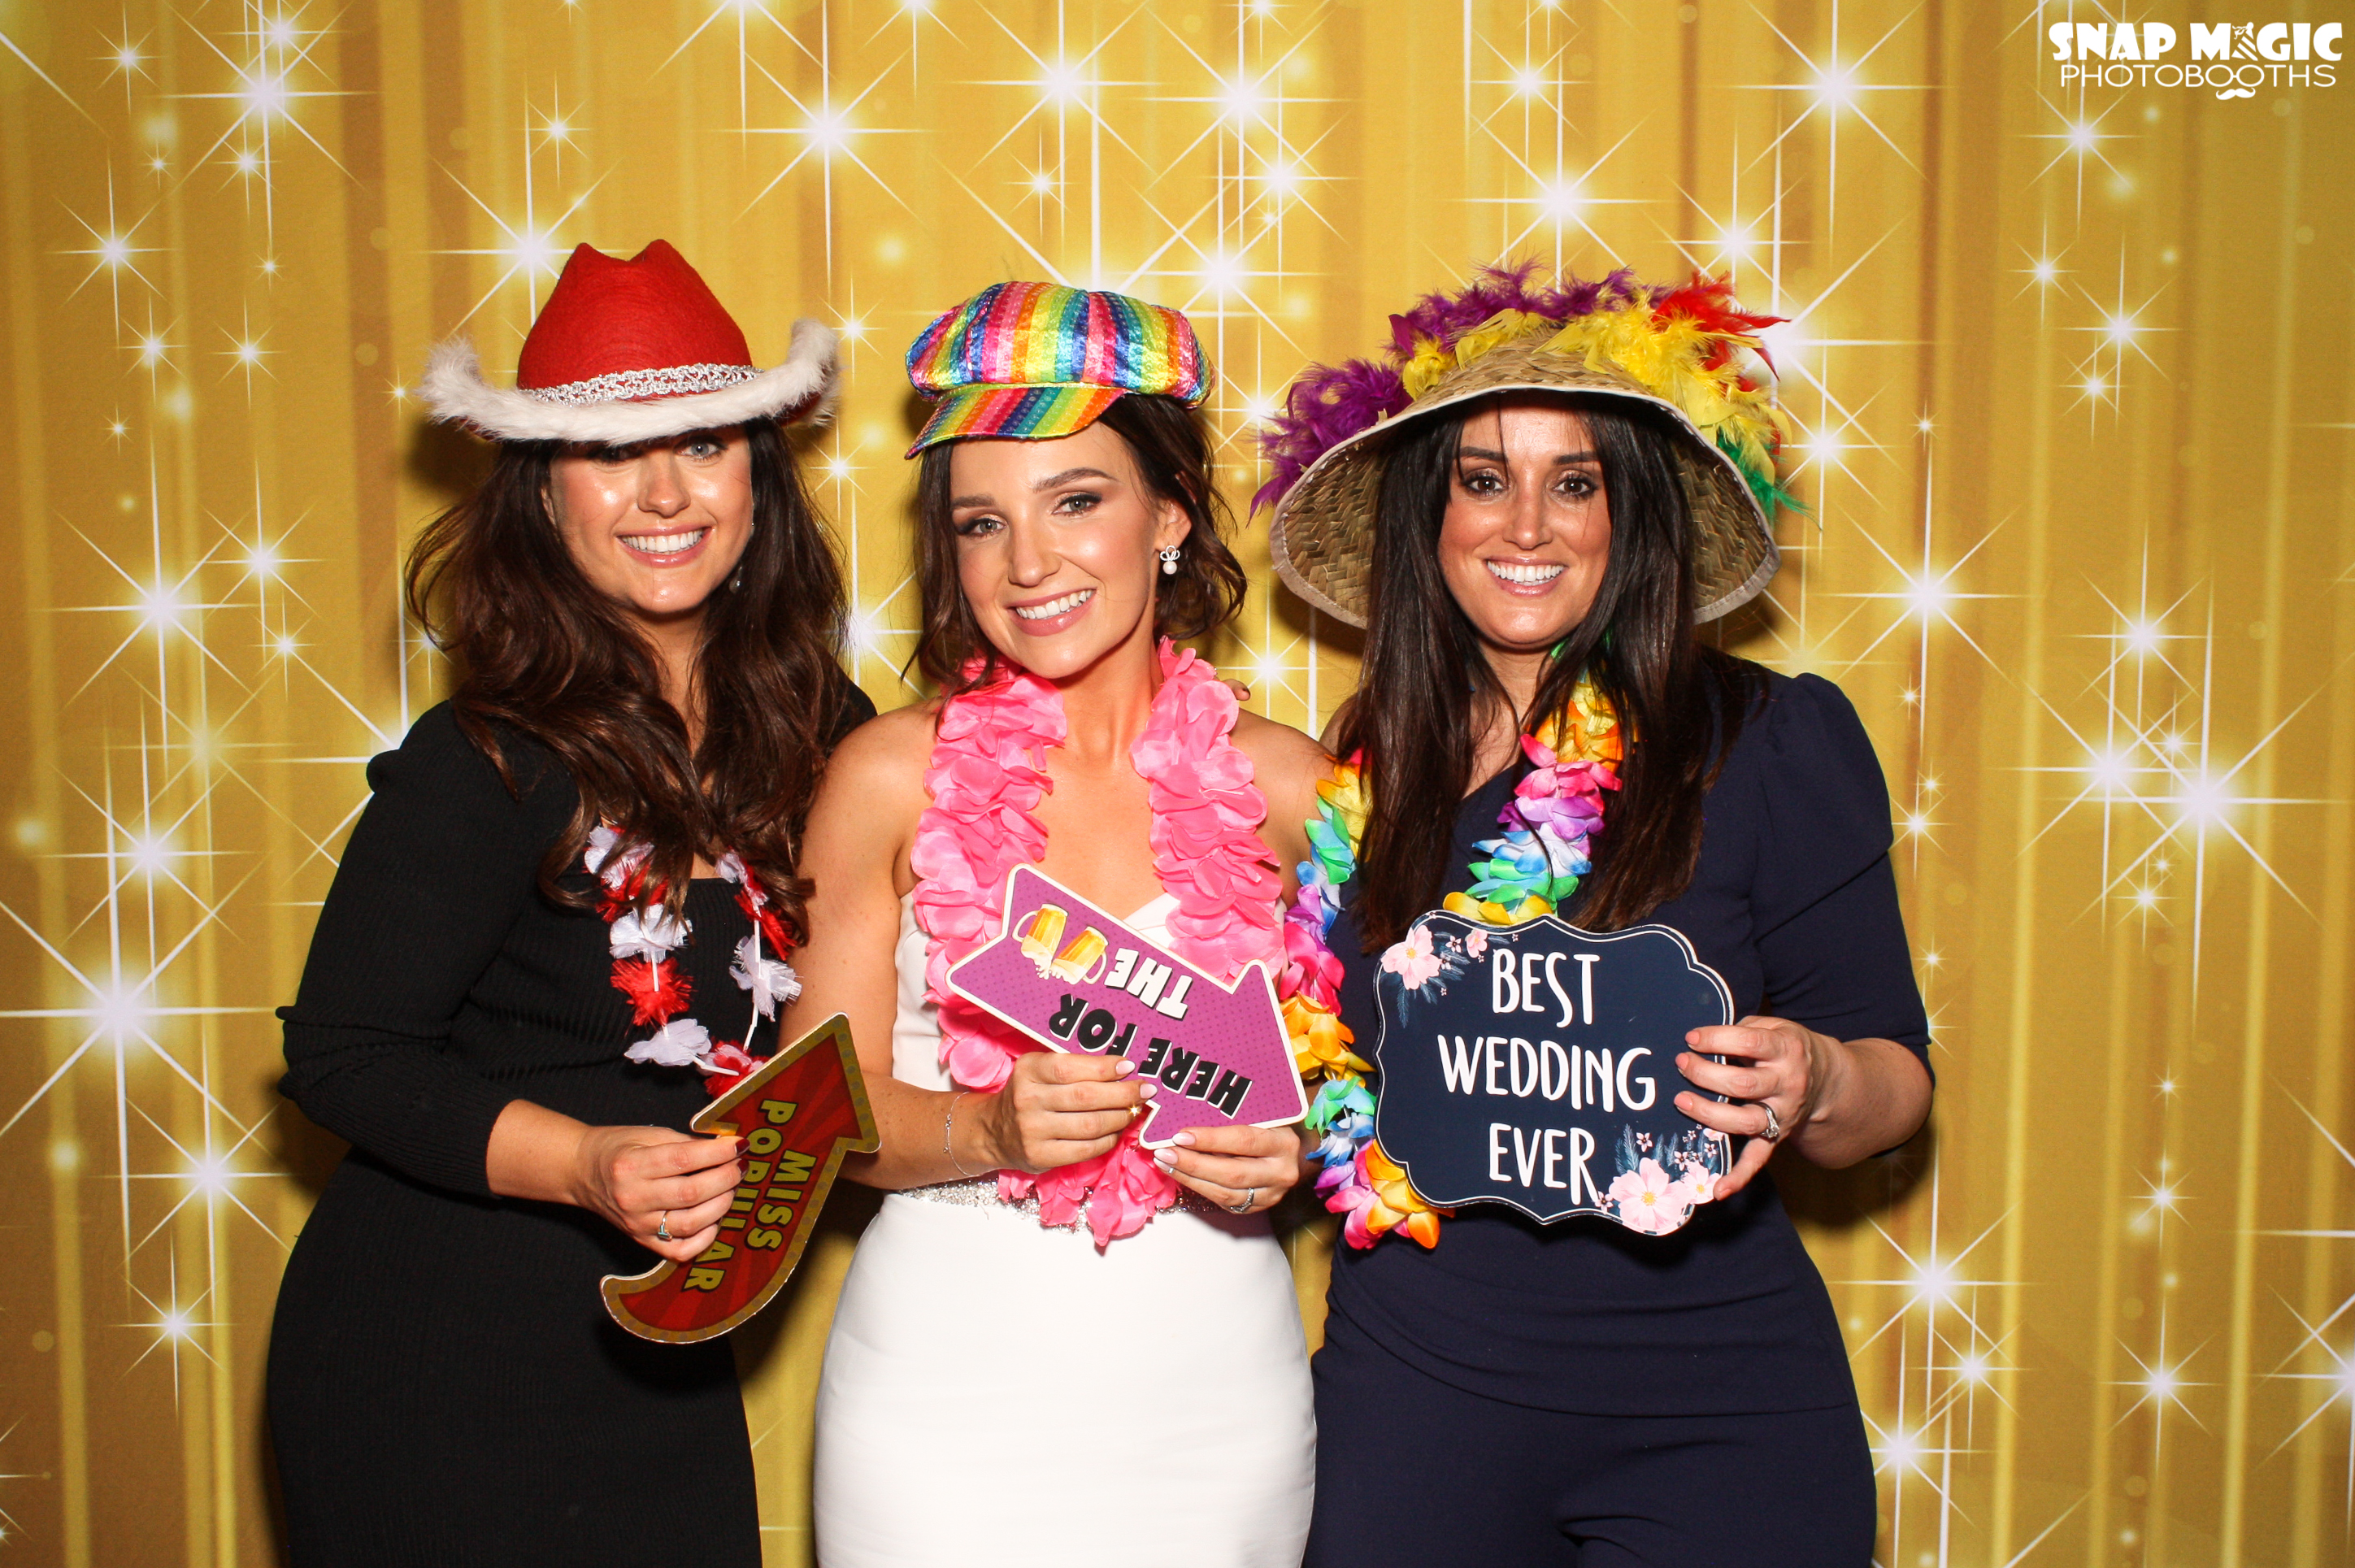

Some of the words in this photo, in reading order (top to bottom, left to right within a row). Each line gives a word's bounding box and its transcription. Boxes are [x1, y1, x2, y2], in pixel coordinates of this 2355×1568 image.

[1104, 948, 1193, 1020] THE
[1493, 949, 1600, 1027] BEST
[1049, 993, 1138, 1057] FOR
[1138, 1037, 1253, 1119] HERE
[1437, 1034, 1656, 1112] WEDDING
[745, 1149, 817, 1251] MISS
[1489, 1123, 1598, 1205] EVER
